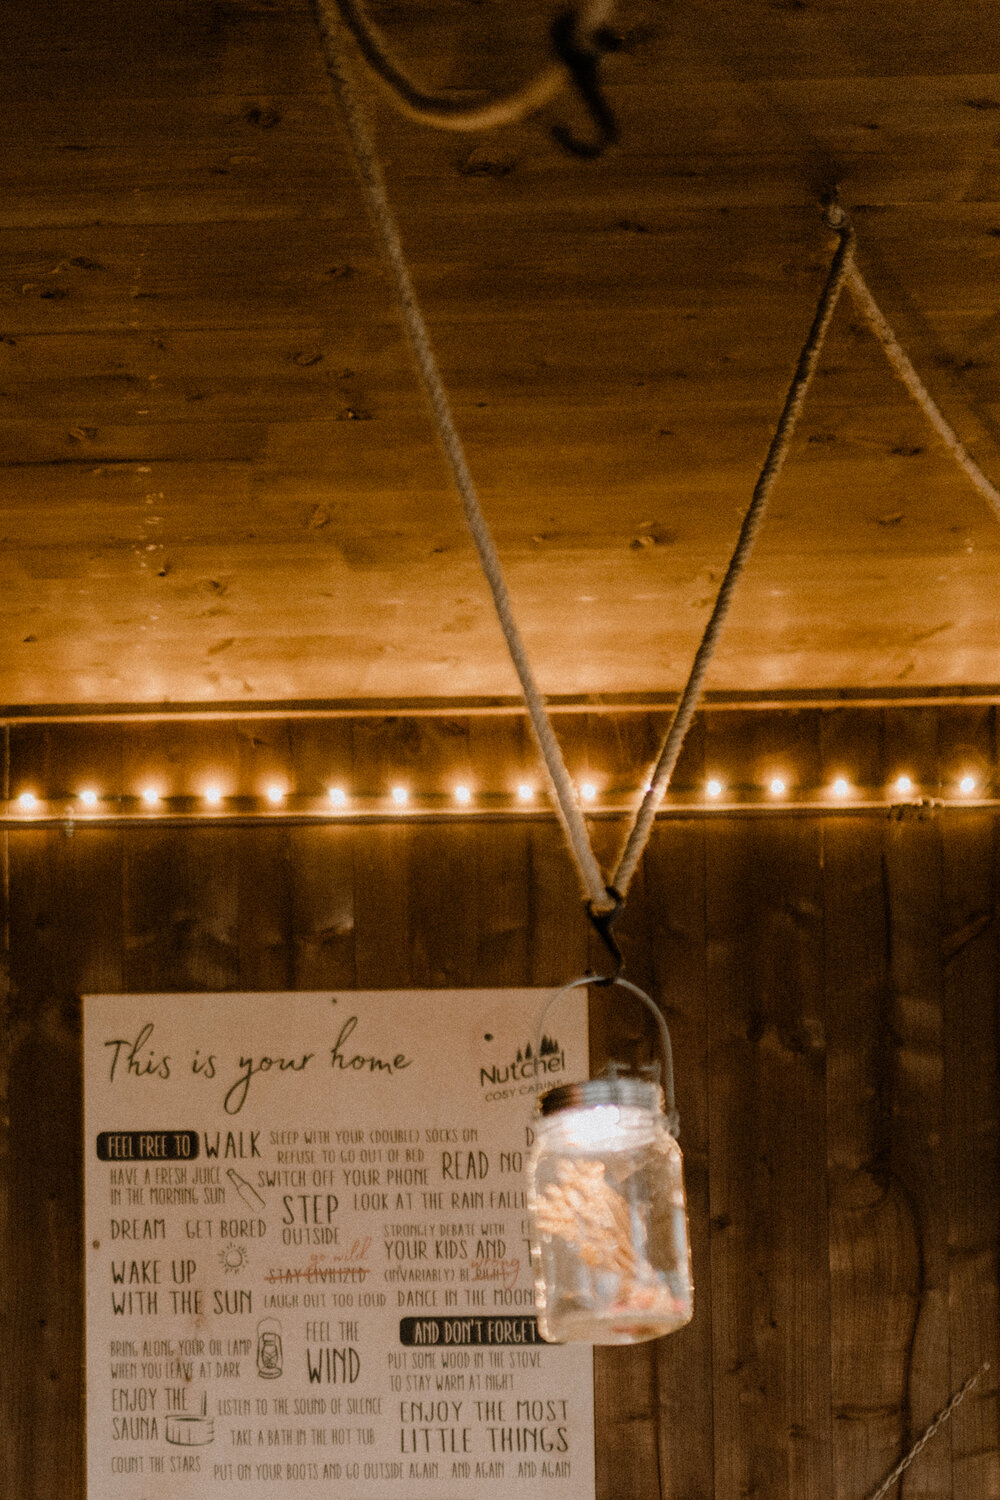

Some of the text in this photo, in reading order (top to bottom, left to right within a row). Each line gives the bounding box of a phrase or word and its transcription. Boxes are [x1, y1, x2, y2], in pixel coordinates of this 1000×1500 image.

[104, 1016, 413, 1115] This is your home
[480, 1050, 565, 1086] Nutchel
[107, 1135, 191, 1157] FEEL FREE TO
[204, 1131, 262, 1158] WALK
[270, 1130, 299, 1144] SLEEP
[304, 1130, 330, 1144] WITH
[336, 1130, 365, 1144] YOUR
[425, 1129, 458, 1143] SOCKS
[462, 1129, 478, 1143] ON
[278, 1149, 424, 1164] REFUSE TO GO OUT OF BED
[442, 1151, 489, 1180] READ
[110, 1167, 222, 1185] HAVE A FRESH JUICE
[258, 1170, 429, 1187] SWITCH OFF YOUR PHONE
[110, 1187, 226, 1205] IN THE MORNING SUN
[354, 1193, 389, 1211] LOOK
[396, 1192, 413, 1209] AT
[421, 1192, 444, 1209] THE
[452, 1192, 484, 1209] RAIN
[282, 1195, 339, 1225] STEP
[111, 1219, 166, 1240] DREAM
[186, 1219, 267, 1238] GET BORED
[282, 1228, 340, 1246] OUTSIDE
[384, 1223, 435, 1237] STRONGLY
[440, 1223, 475, 1237] DEBATE
[481, 1223, 505, 1237] WITH
[384, 1240, 507, 1260] YOUR KIDS AND
[111, 1260, 197, 1285] WAKE UP
[111, 1291, 252, 1315] WITH THE SUN
[264, 1294, 387, 1308] LAUGH OUT TOO LOUD
[397, 1290, 437, 1307] DANCE
[445, 1290, 458, 1307] IN
[465, 1290, 486, 1307] THE
[306, 1321, 360, 1341] FEEL THE
[414, 1320, 537, 1344] AND DON'T FORGET
[110, 1340, 252, 1356] BRING ALONG YOUR OIL LAMP
[307, 1347, 360, 1384] WIND
[388, 1351, 407, 1369] PUT
[412, 1351, 436, 1369] SOME
[441, 1351, 470, 1369] WOOD
[474, 1351, 484, 1369] IN
[488, 1351, 506, 1369] THE
[111, 1362, 240, 1379] WHEN YOU LEAVE AT DARK
[390, 1374, 515, 1392] TO STAY WARM AT NIGHT
[112, 1387, 188, 1411] ENJOY THE
[217, 1399, 382, 1415] LISTEN TO THE SOUND OF SILENCE
[400, 1400, 569, 1422] ENJOY THE MOST
[112, 1417, 159, 1441] SAUNA
[230, 1429, 375, 1446] TAKE A BATH IN THE HOT TUB
[400, 1427, 569, 1453] LITTLE THINGS
[111, 1456, 201, 1473] COUNT THE STARS
[213, 1464, 233, 1480] PUT
[237, 1464, 251, 1480] ON
[255, 1464, 282, 1480] YOUR
[286, 1464, 319, 1480] BOOTS
[323, 1463, 342, 1479] AND
[346, 1463, 359, 1479] GO
[364, 1463, 404, 1479] OUTSIDE
